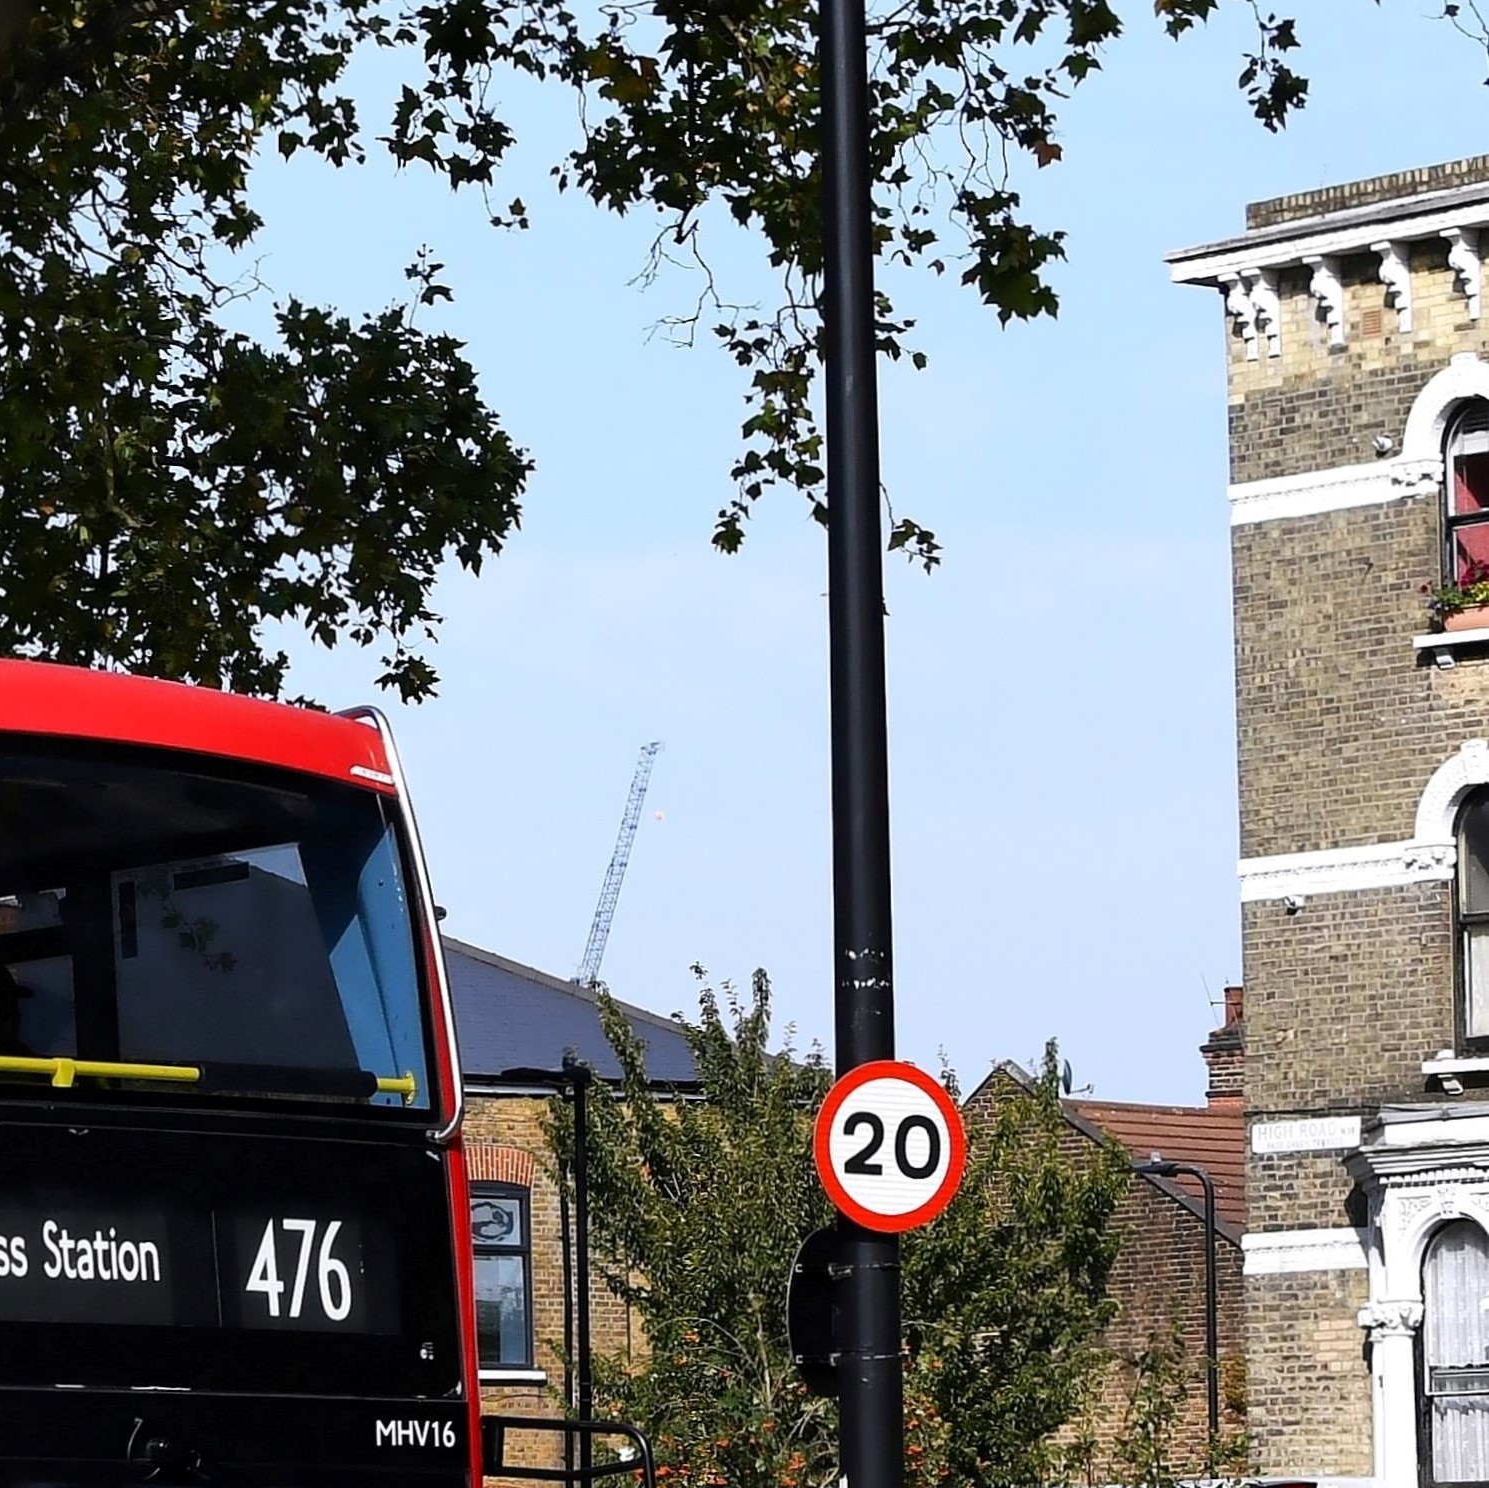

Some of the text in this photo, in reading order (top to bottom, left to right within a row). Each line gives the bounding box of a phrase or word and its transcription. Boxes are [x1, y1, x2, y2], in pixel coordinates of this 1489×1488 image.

[843, 1111, 941, 1179] 20
[1258, 1125, 1293, 1140] HIGH
[1300, 1122, 1336, 1137] ROAD
[42, 1219, 161, 1282] Station
[245, 1217, 352, 1321] 476
[375, 1419, 456, 1448] MHV16
